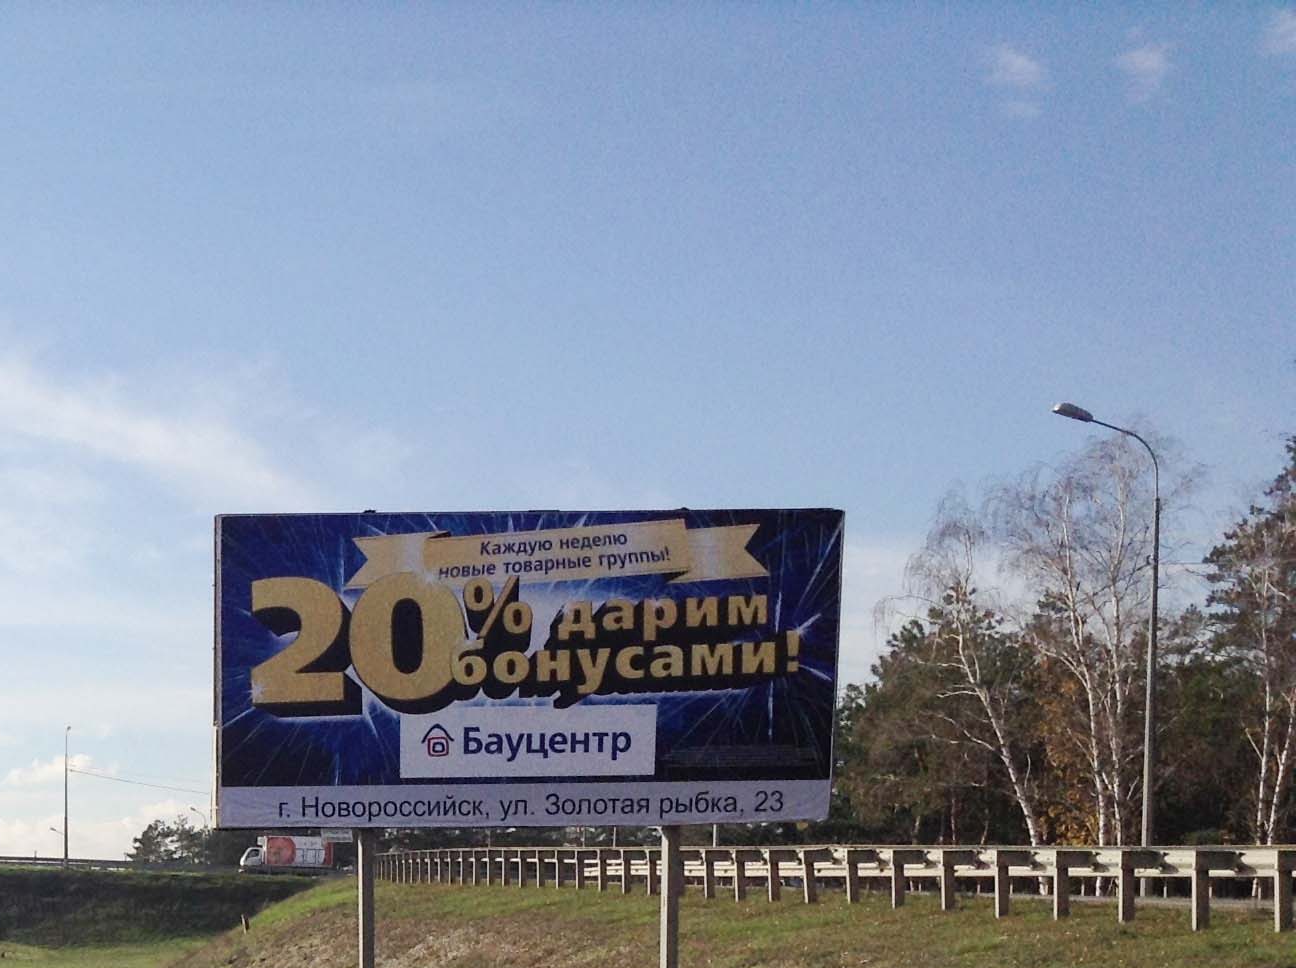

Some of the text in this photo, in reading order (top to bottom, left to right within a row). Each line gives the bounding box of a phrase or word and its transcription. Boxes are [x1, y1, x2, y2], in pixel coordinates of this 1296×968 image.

[480, 532, 628, 557] Каждую неделю
[439, 546, 671, 579] новые товарные группы!
[558, 594, 768, 640] дарим
[450, 630, 801, 695] бонусами!
[462, 726, 633, 761] Бауцентр
[278, 790, 785, 822] г. Новороссийск, ул. Золотая рыбка, 23
